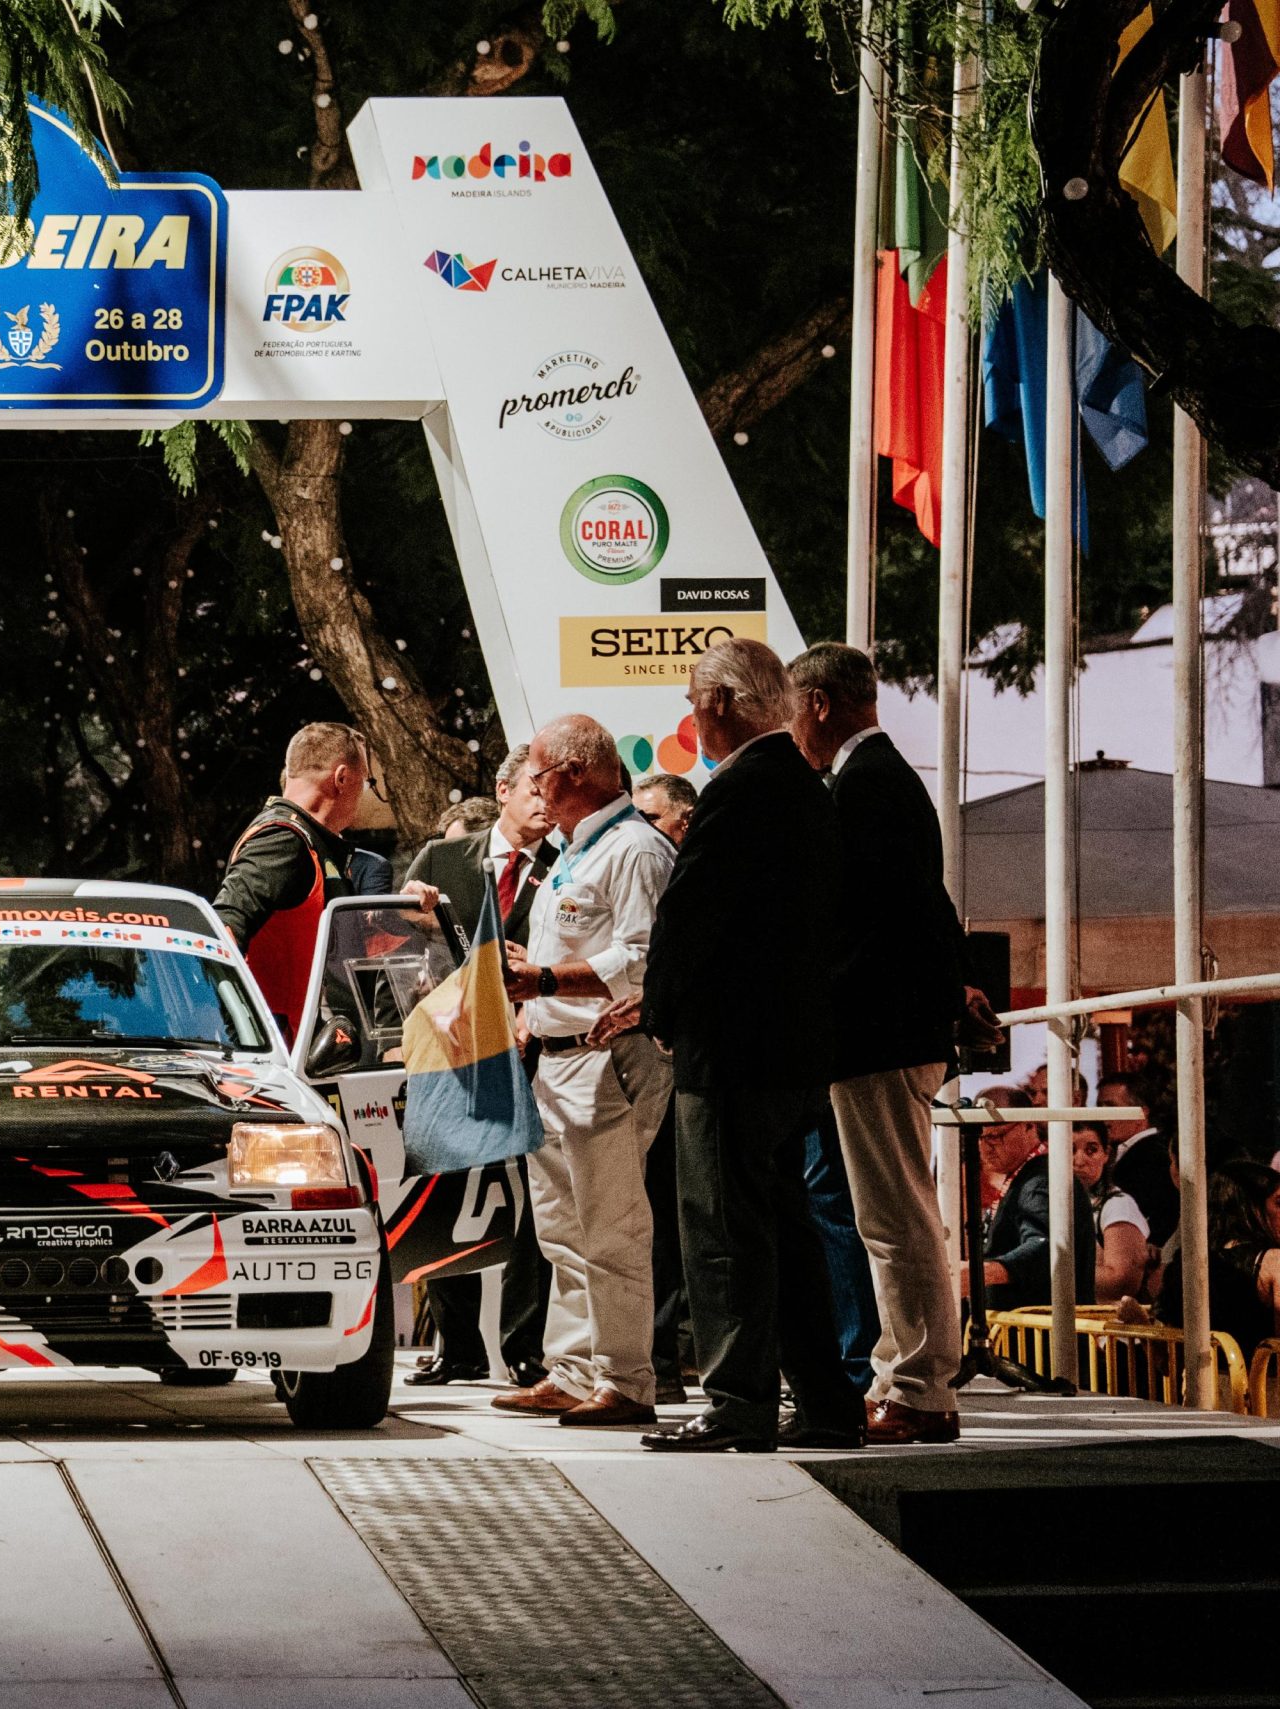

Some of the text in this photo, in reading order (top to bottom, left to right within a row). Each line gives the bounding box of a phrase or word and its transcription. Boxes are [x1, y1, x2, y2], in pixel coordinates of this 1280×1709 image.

[262, 294, 351, 322] FPAK
[94, 308, 183, 330] 26 a 28
[86, 341, 189, 362] Outubro
[263, 340, 304, 349] FEDERAÇÃO
[537, 354, 600, 380] MARKETING
[499, 366, 638, 429] promerch
[582, 520, 648, 540] CORAL
[598, 554, 634, 563] PREMIUM
[677, 590, 750, 600] DAVID ROSAS
[624, 664, 694, 675] SINCE 188
[14, 1085, 162, 1098] RENTAL
[37, 1239, 113, 1249] creative graphics
[263, 1236, 341, 1244] RESTAURANTE
[233, 1261, 371, 1281] AUTO BG
